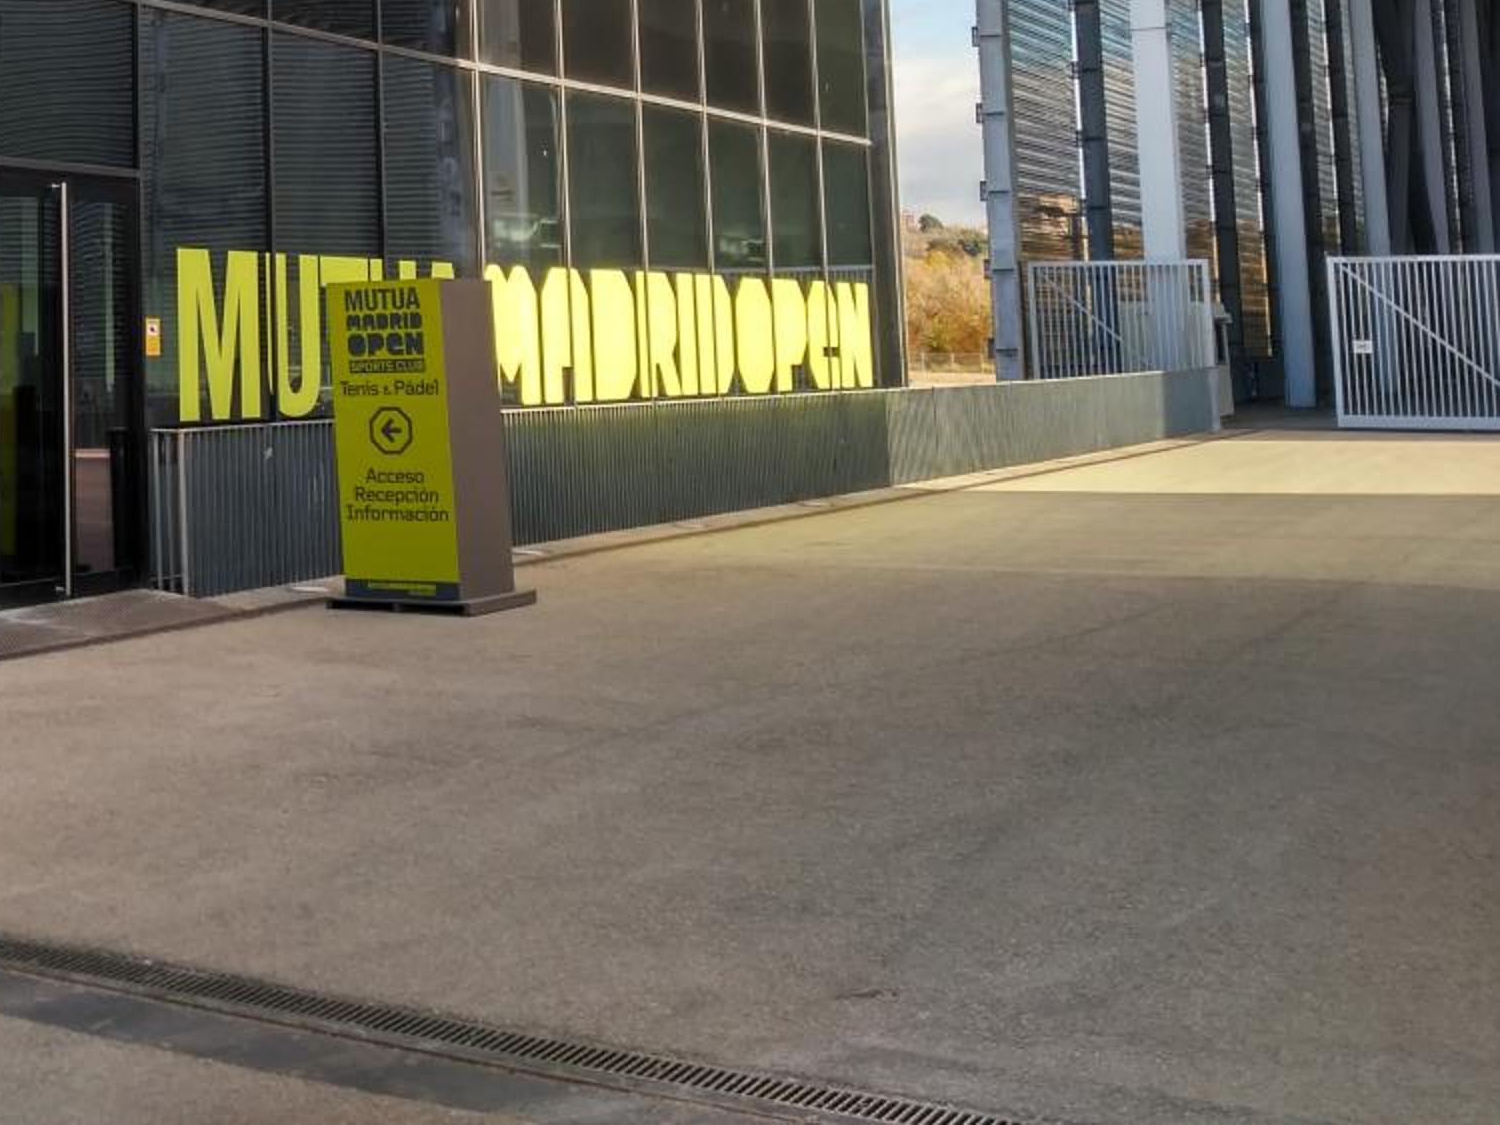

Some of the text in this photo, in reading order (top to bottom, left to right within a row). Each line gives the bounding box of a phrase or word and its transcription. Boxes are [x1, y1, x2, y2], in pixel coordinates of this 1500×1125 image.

[344, 286, 421, 312] MUTUA
[346, 312, 423, 331] MADRID
[347, 332, 425, 357] OPEN
[339, 380, 379, 396] Tenis
[365, 467, 425, 484] Acceso
[354, 486, 440, 506] Recepción
[346, 504, 450, 522] Información
